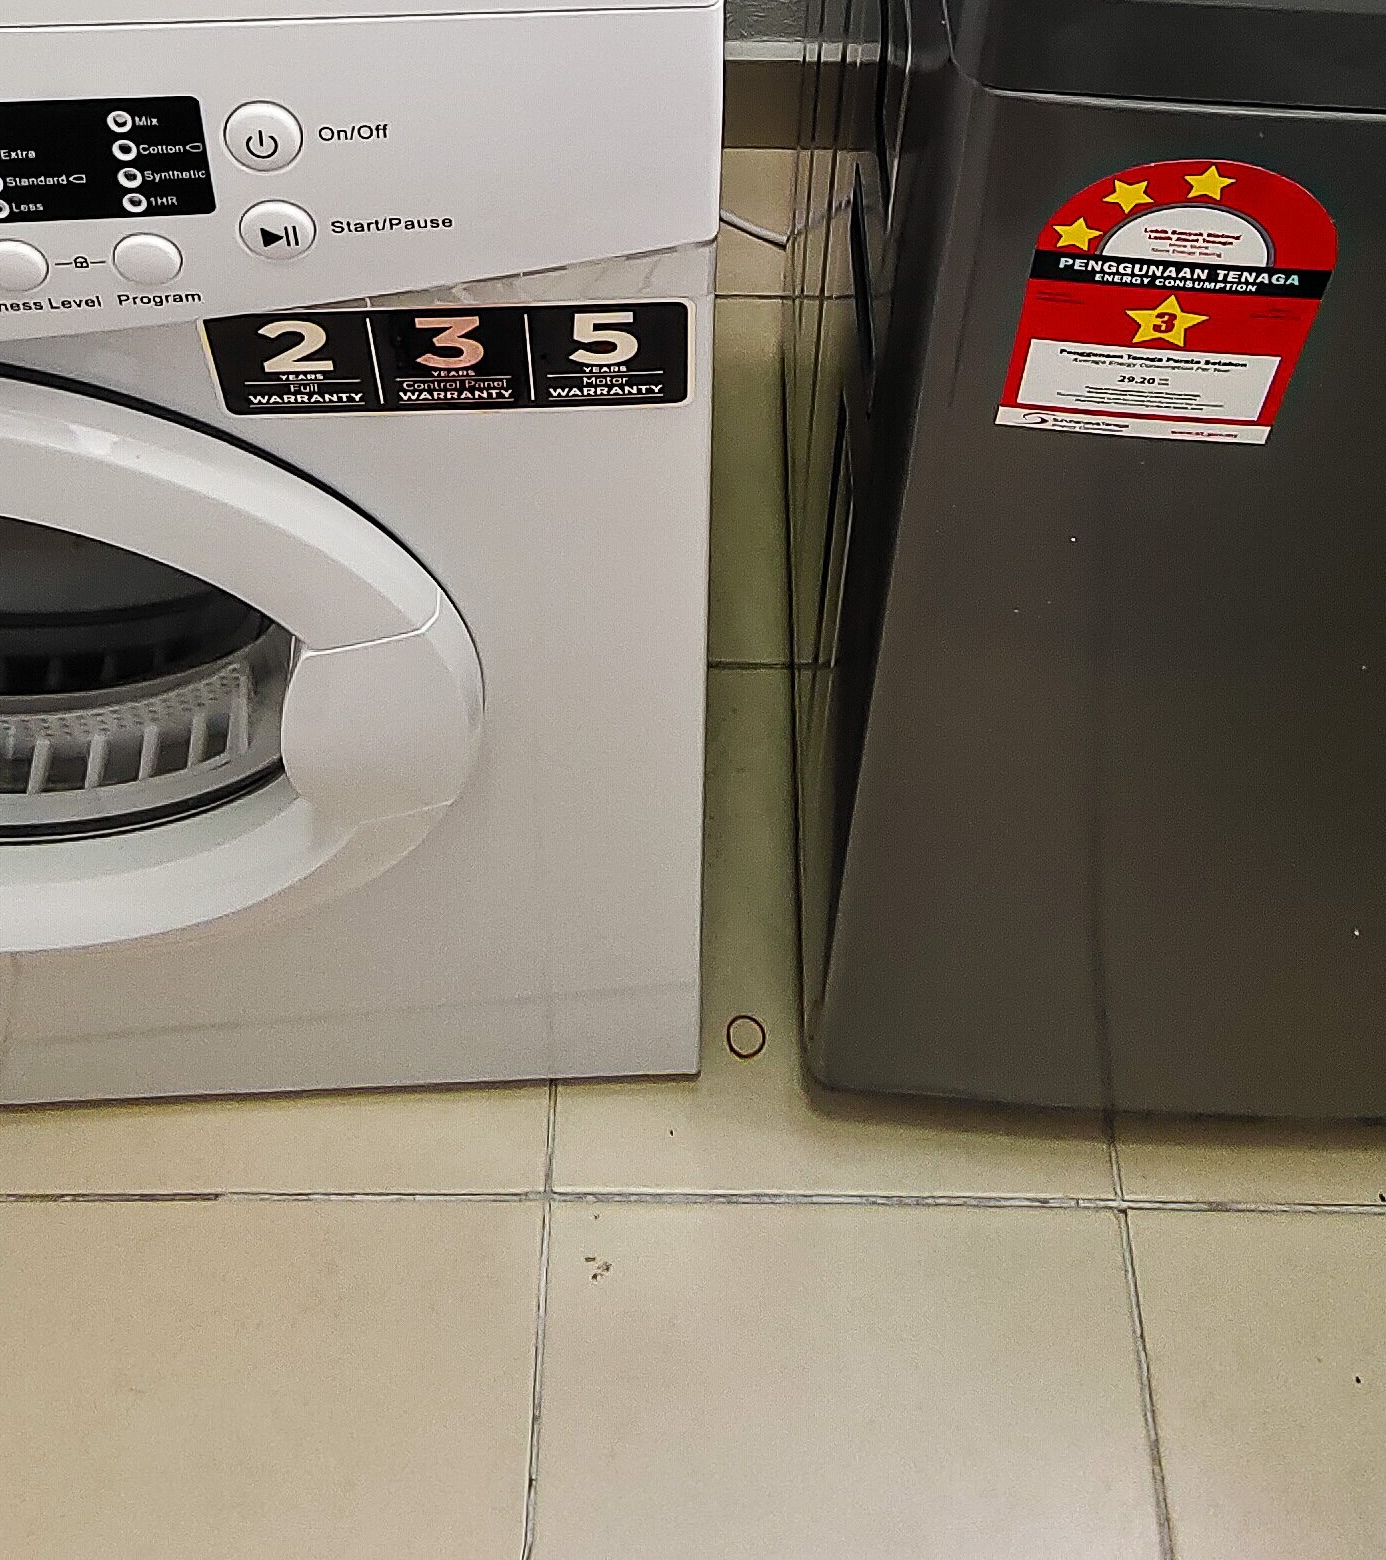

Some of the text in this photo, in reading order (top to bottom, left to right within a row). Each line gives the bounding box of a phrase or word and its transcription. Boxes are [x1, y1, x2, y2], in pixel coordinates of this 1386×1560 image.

[134, 115, 160, 127] Mix
[318, 122, 388, 142] On/Off
[1, 148, 36, 161] Extra
[139, 142, 184, 155] Cotton
[6, 174, 68, 188] Standard
[144, 168, 206, 184] Synthetic
[150, 195, 178, 208] 1HR
[330, 214, 454, 234] Start/Pause
[1058, 257, 1300, 287] PENGGUNAAN TENAGA
[1094, 273, 1258, 293] ENERGY CONSUMPTION
[48, 295, 102, 312] Level
[117, 290, 202, 310] Program
[1152, 312, 1179, 334] 3
[414, 314, 485, 369] 3
[568, 311, 639, 364] 5
[256, 319, 334, 373] 2
[279, 373, 324, 381] YEARS
[583, 374, 628, 386] Motor
[290, 383, 319, 393] Full
[398, 389, 513, 402] WARRANTY
[548, 384, 664, 398] WARRANTY
[248, 391, 364, 404] WARRANTY
